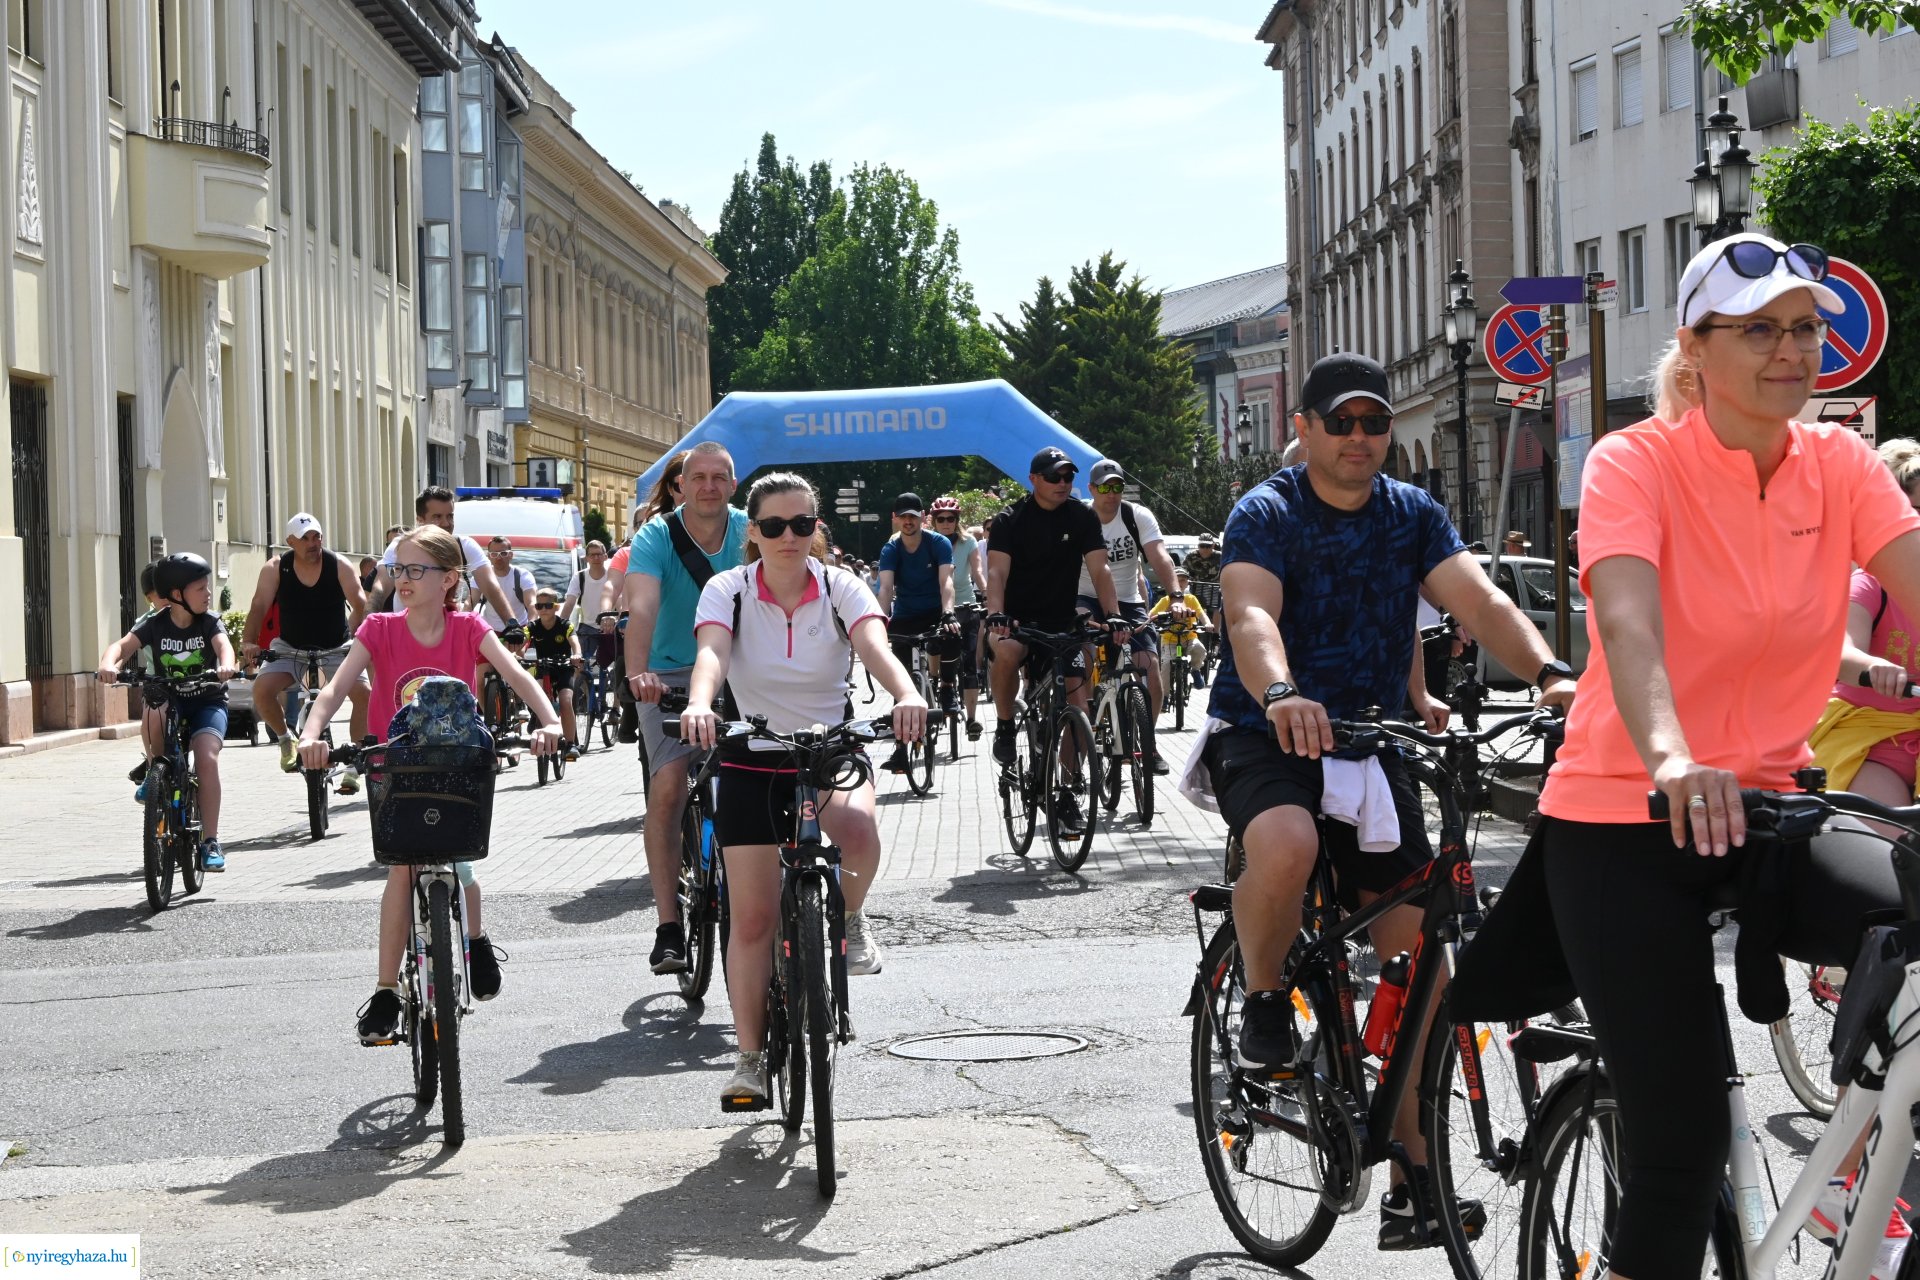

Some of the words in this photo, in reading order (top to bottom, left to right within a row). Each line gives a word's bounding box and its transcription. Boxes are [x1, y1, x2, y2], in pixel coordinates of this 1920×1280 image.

[784, 407, 946, 436] SHIMANO
[1108, 547, 1134, 562] NES
[161, 638, 183, 652] GOOD
[185, 636, 205, 650] VIBES
